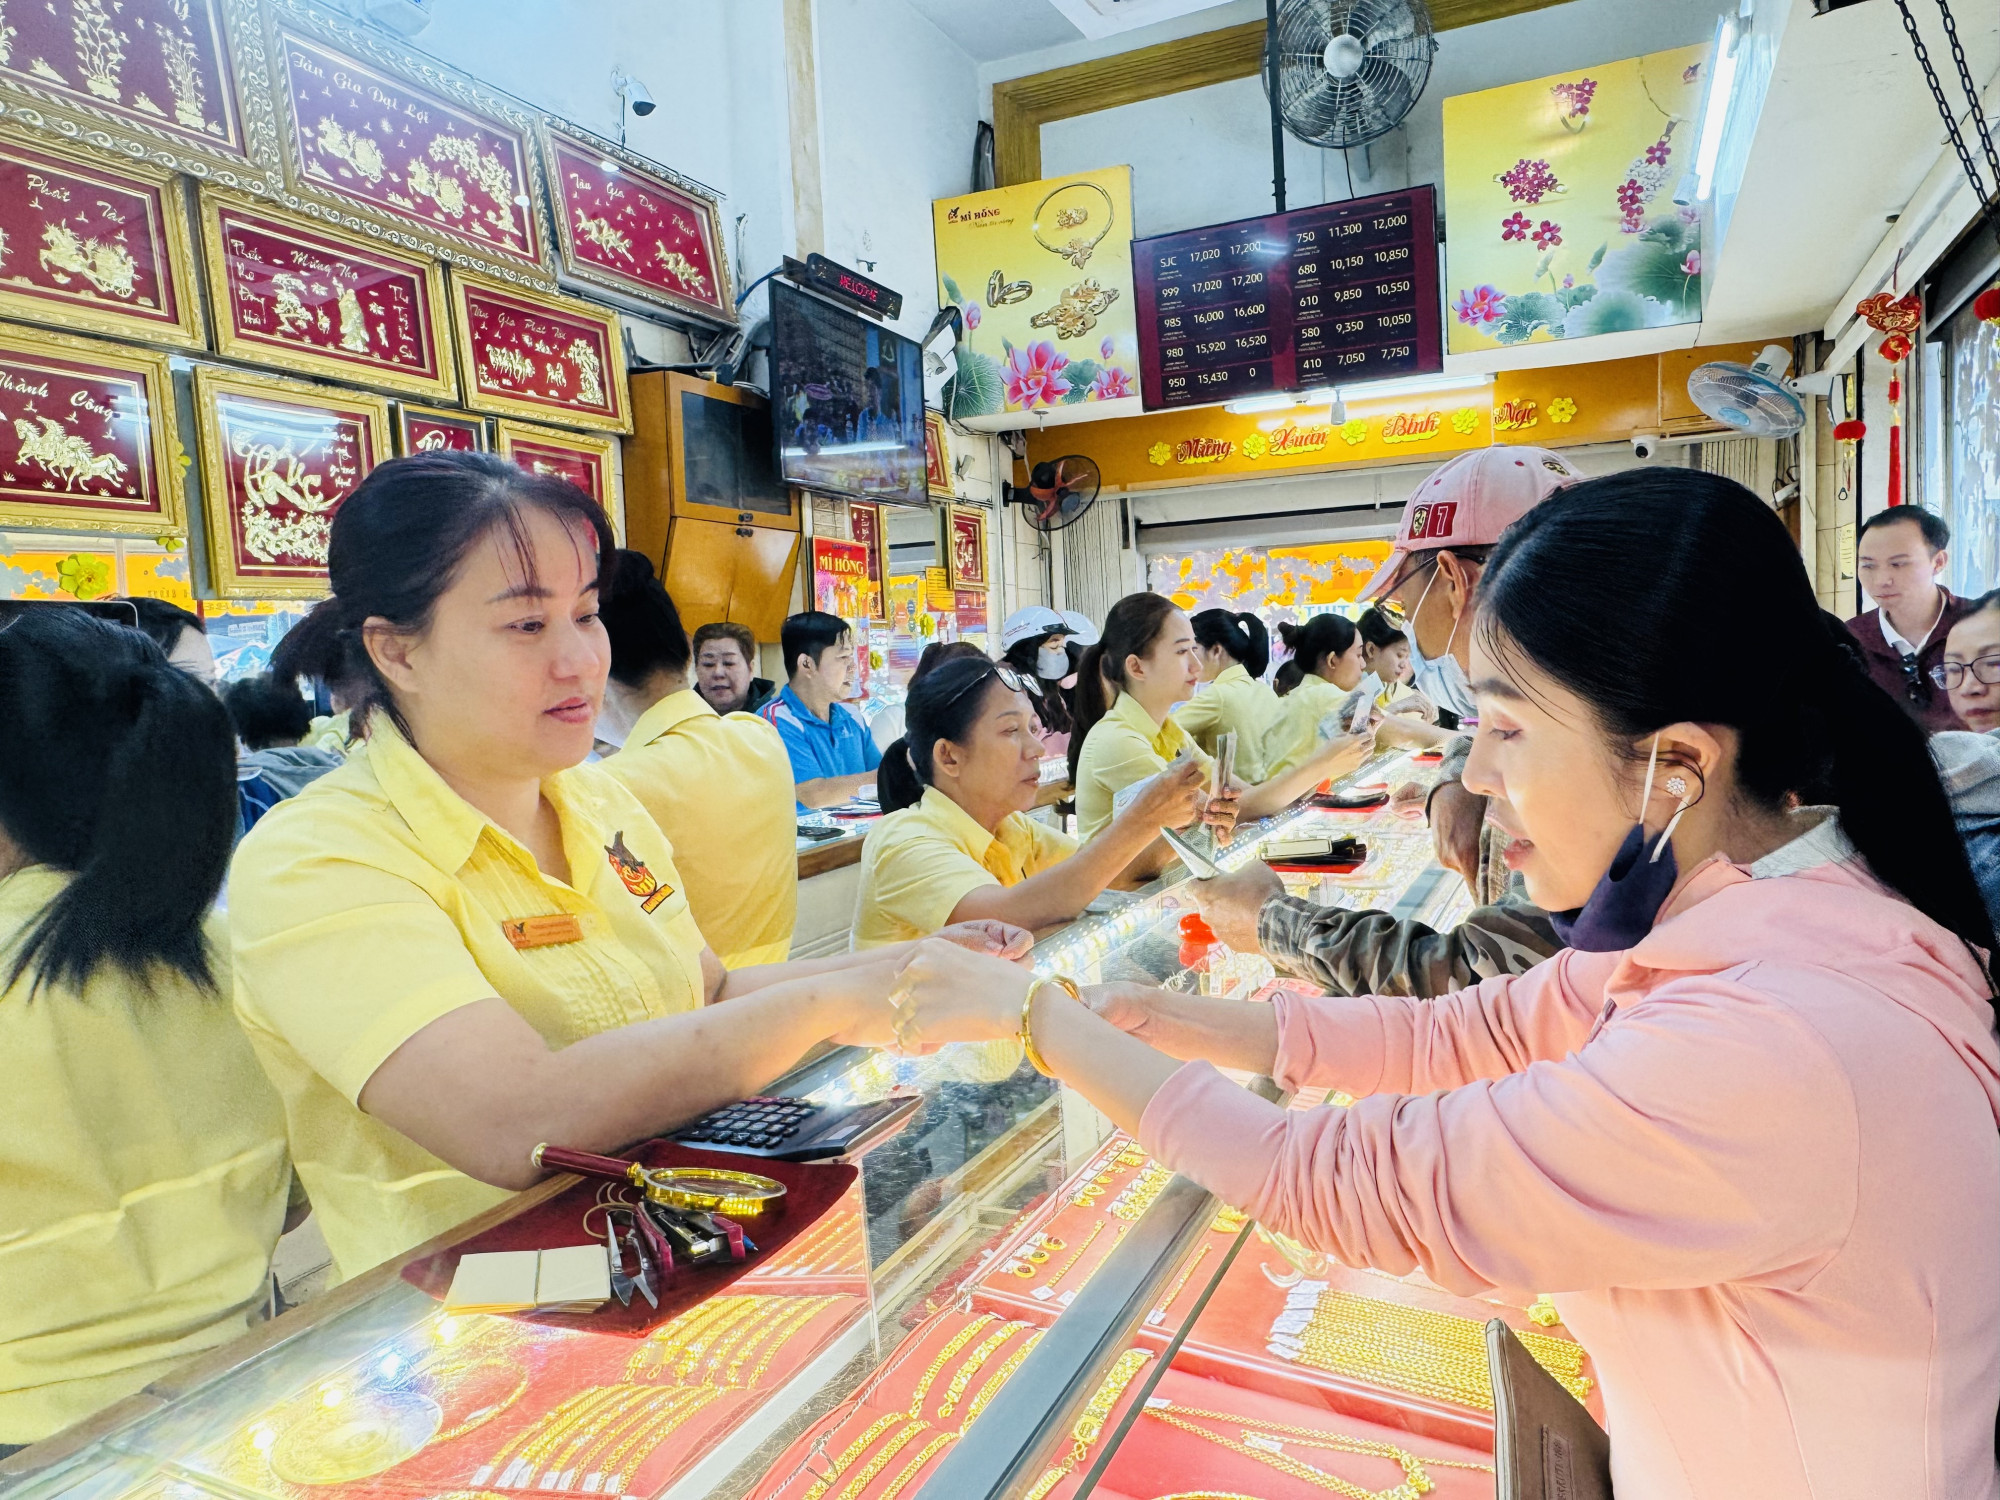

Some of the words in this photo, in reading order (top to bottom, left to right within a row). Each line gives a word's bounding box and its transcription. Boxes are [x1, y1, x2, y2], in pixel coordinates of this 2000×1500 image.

[26, 174, 72, 202] Phát
[1296, 232, 1315, 244] 750
[1328, 222, 1362, 238] 11,300
[1372, 214, 1407, 230] 12,000
[1160, 256, 1177, 268] SJC
[1190, 248, 1220, 262] 17,020
[1230, 241, 1261, 256] 17,200
[1298, 264, 1317, 276] 680
[1330, 255, 1364, 270] 10,150
[1374, 248, 1409, 262] 10,850
[1162, 286, 1180, 298] 999
[1192, 280, 1222, 294] 17,020
[1232, 272, 1263, 287] 17,200
[1299, 295, 1319, 307] 610
[1334, 288, 1362, 302] 9,850
[1376, 280, 1410, 296] 10,550
[1164, 317, 1182, 328] 985
[1194, 310, 1224, 324] 16,000
[1234, 304, 1266, 318] 16,600
[1302, 326, 1320, 338] 580
[1336, 320, 1364, 334] 9,350
[1377, 313, 1412, 328] 10,050
[1166, 347, 1184, 358] 980
[1195, 341, 1226, 354] 15,920
[1236, 334, 1267, 348] 16,520
[1303, 358, 1322, 370] 410
[1337, 352, 1366, 366] 7,050
[1380, 346, 1410, 360] 7,750
[1168, 377, 1186, 388] 950
[1198, 371, 1228, 384] 15,430
[1249, 367, 1256, 378] 0
[70, 390, 114, 422] Công
[1436, 506, 1449, 536] 1
